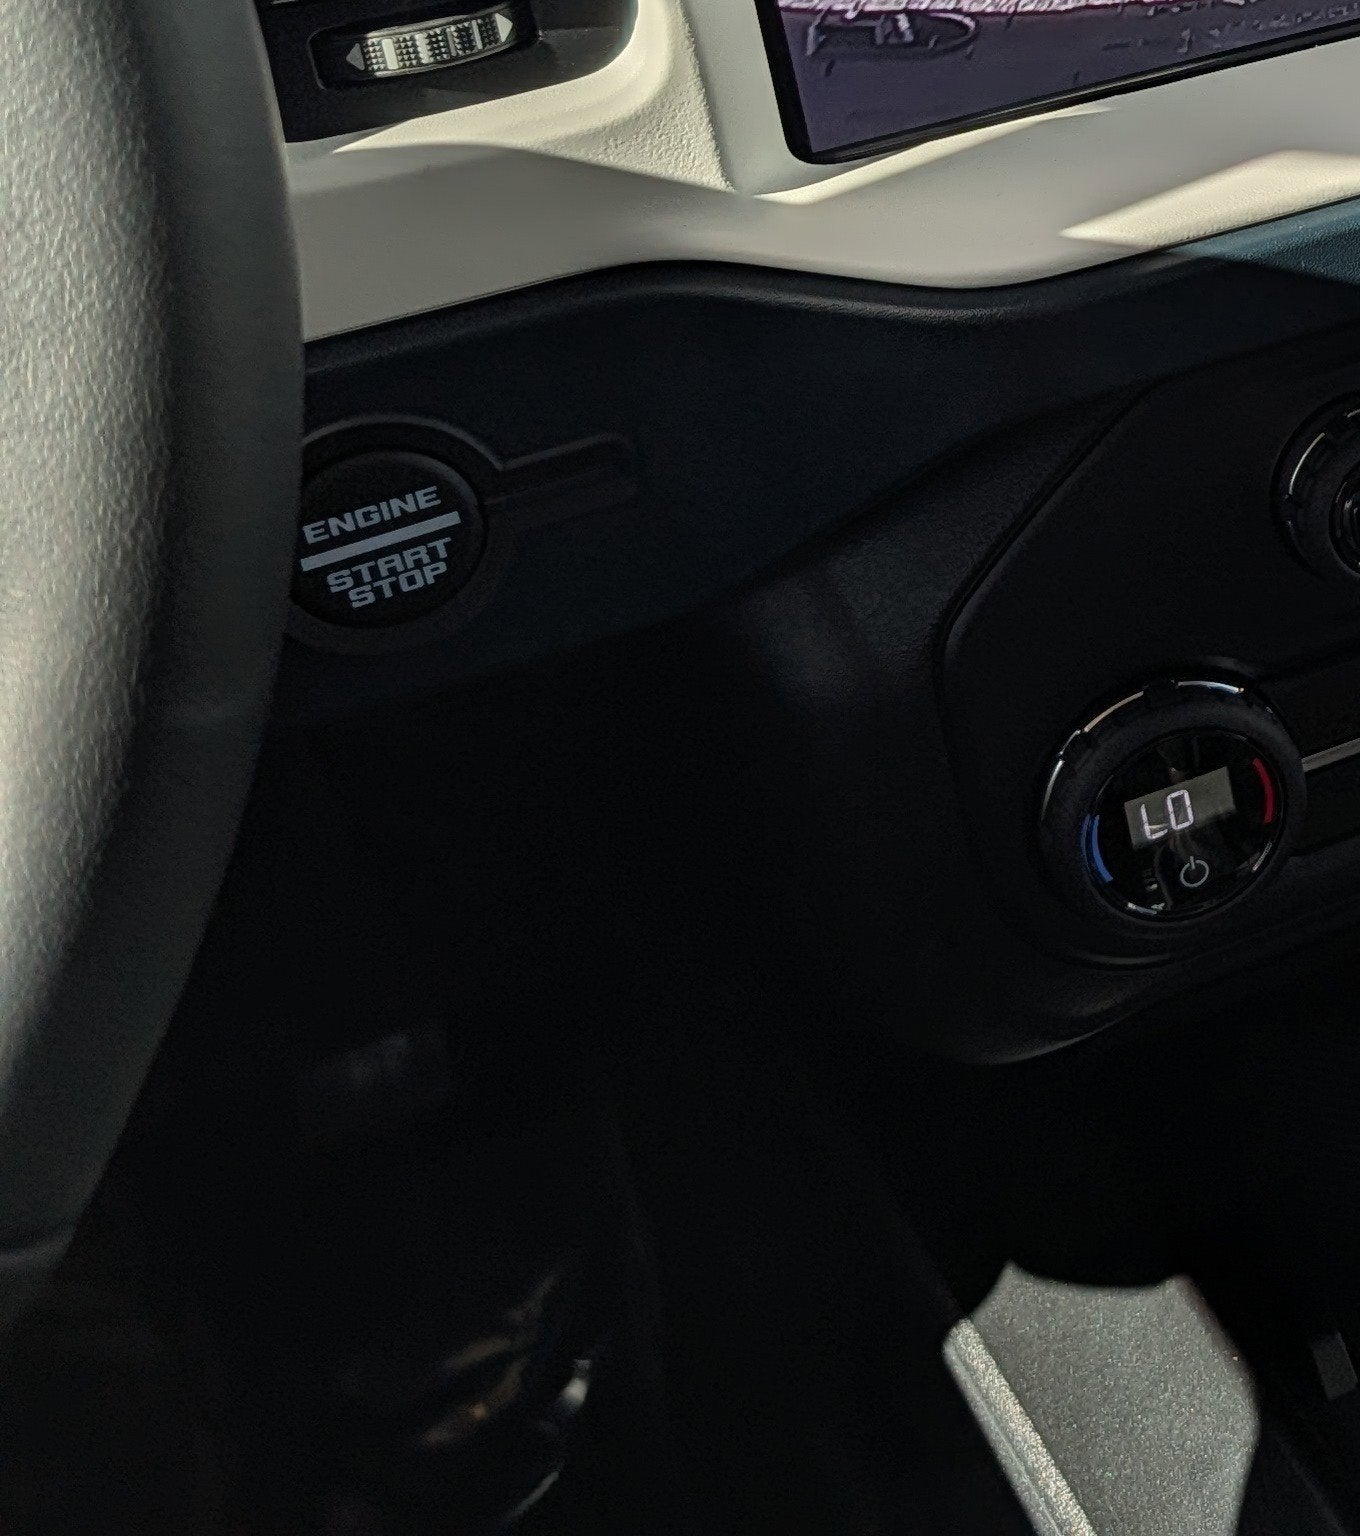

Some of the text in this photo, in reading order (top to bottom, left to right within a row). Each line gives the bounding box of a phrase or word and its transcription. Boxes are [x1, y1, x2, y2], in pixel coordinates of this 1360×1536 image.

[302, 485, 442, 545] ENGINE
[326, 536, 452, 594] START
[348, 561, 448, 609] STOP
[1141, 789, 1195, 842] LO
